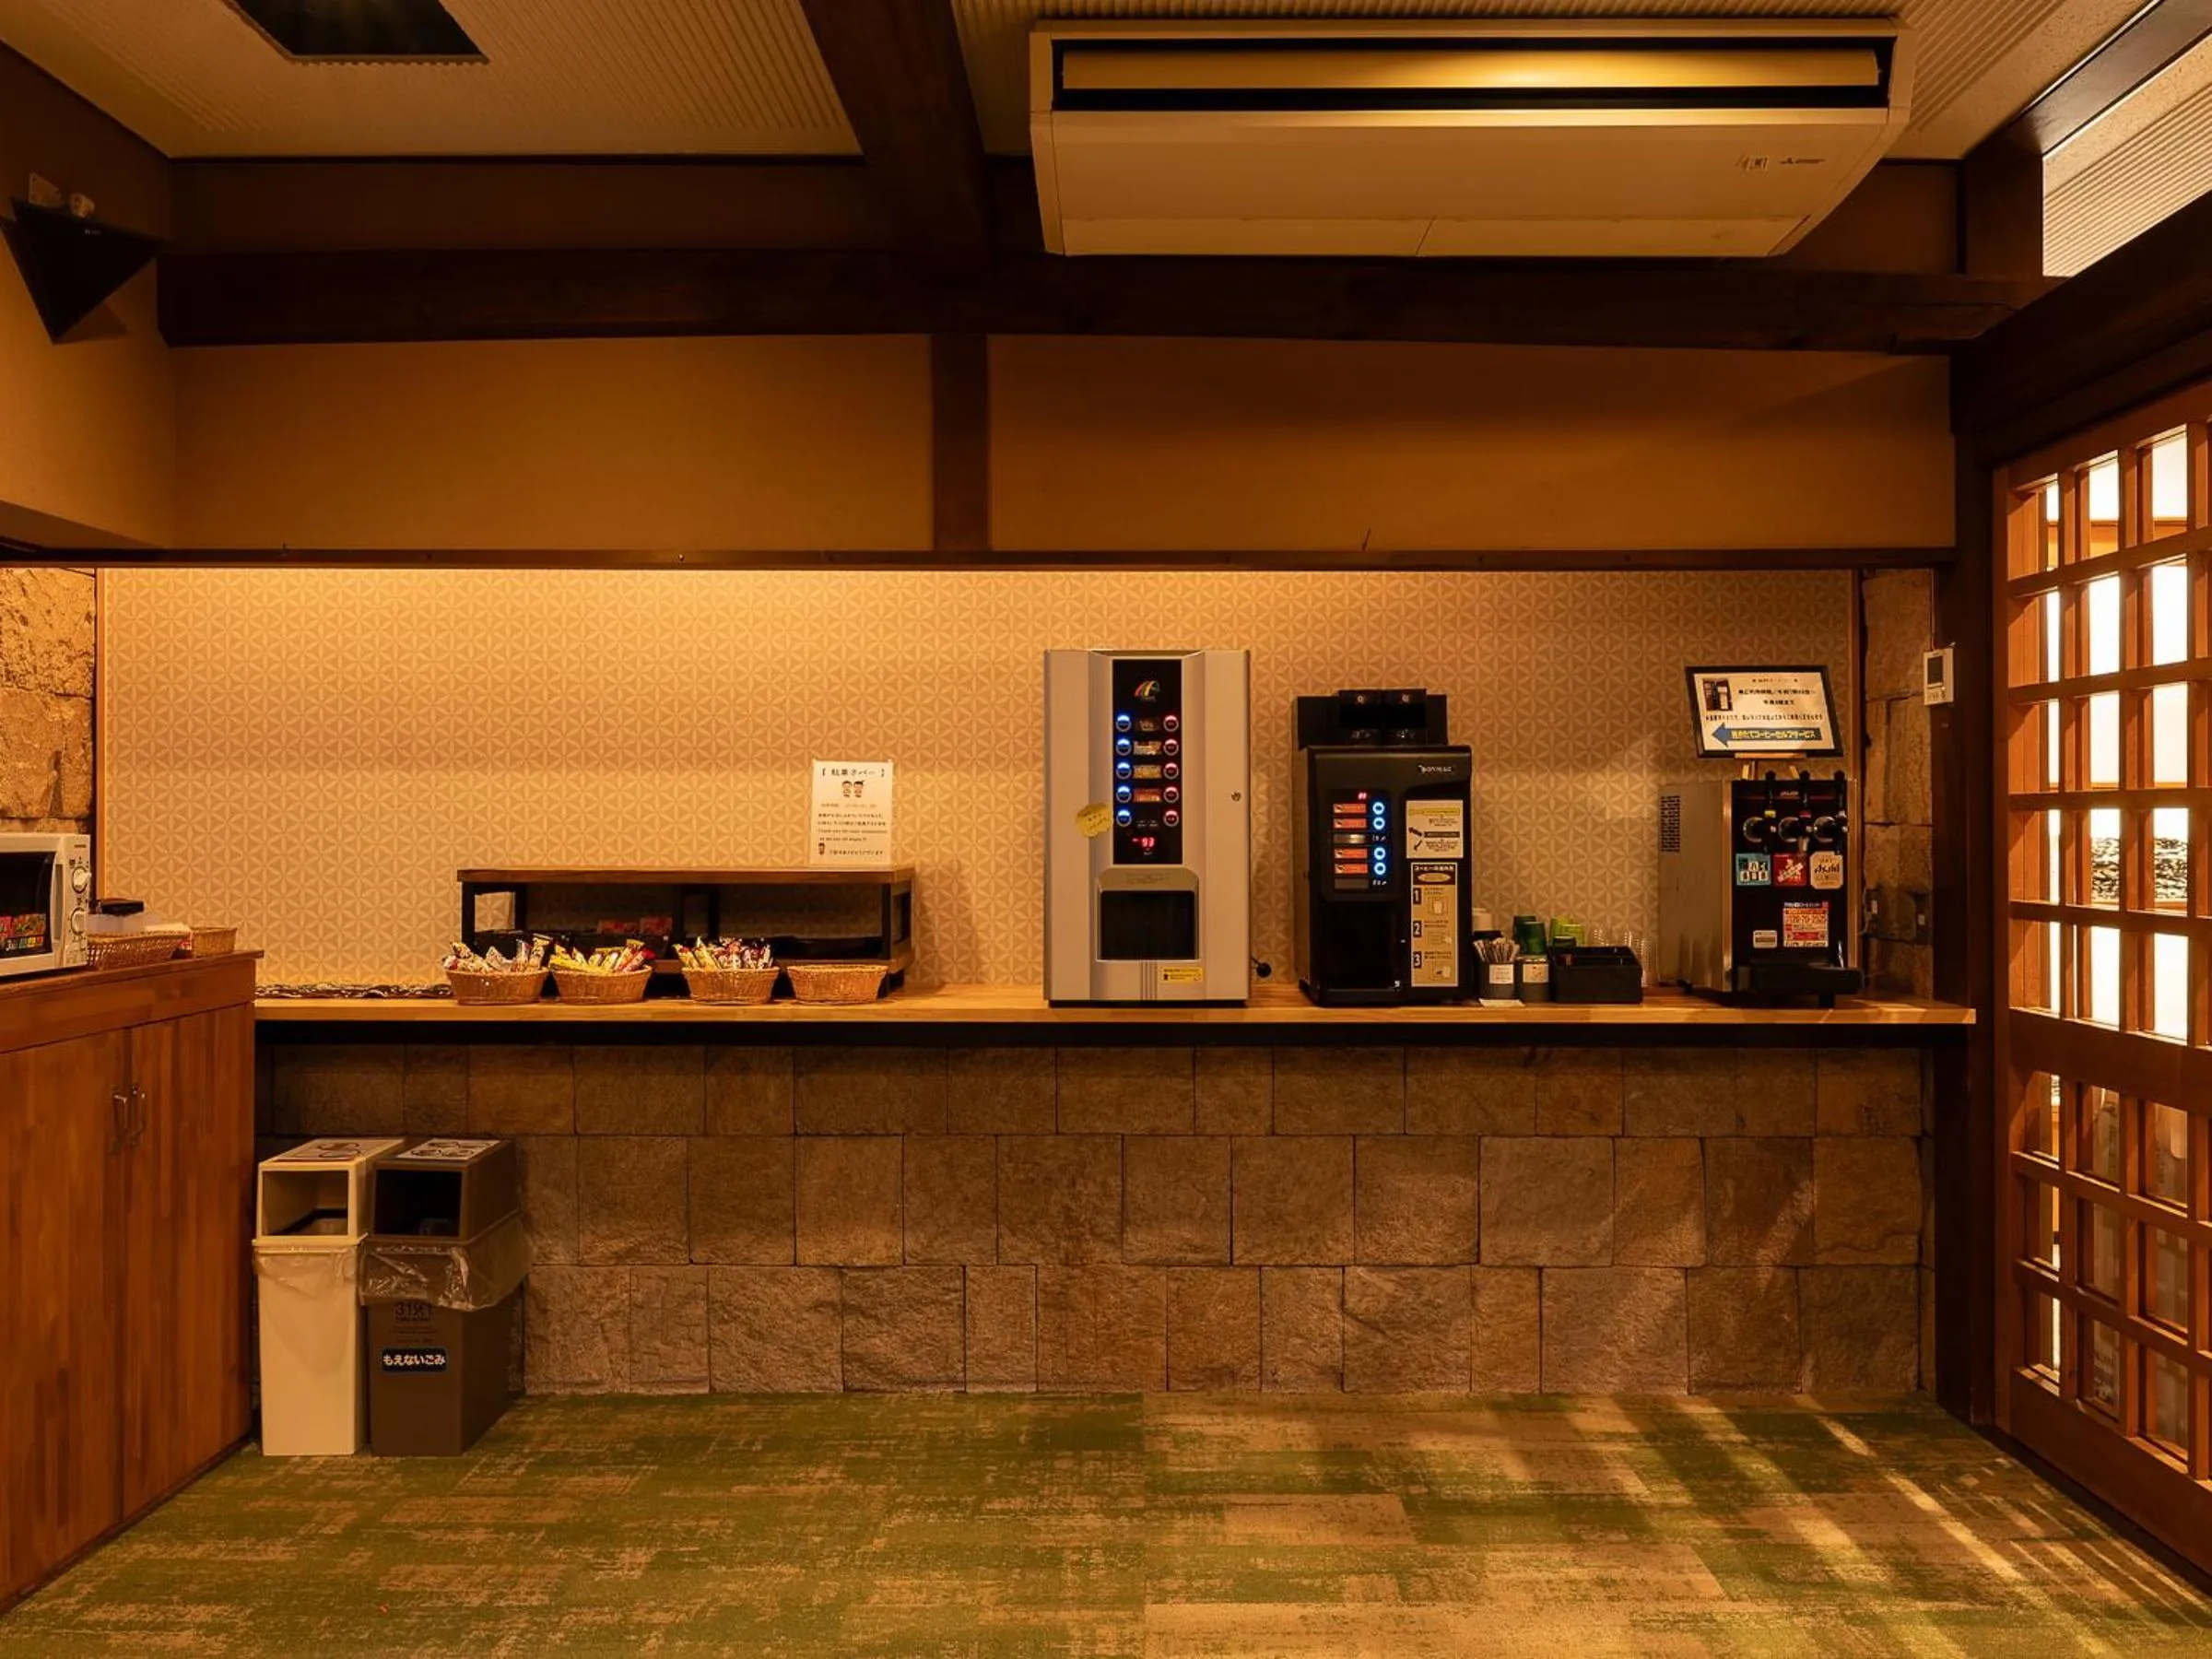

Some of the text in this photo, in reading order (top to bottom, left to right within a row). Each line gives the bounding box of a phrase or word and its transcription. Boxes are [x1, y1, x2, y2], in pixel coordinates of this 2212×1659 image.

[1414, 889, 1419, 900] 1
[1414, 923, 1420, 935] 2
[1414, 954, 1420, 966] 3
